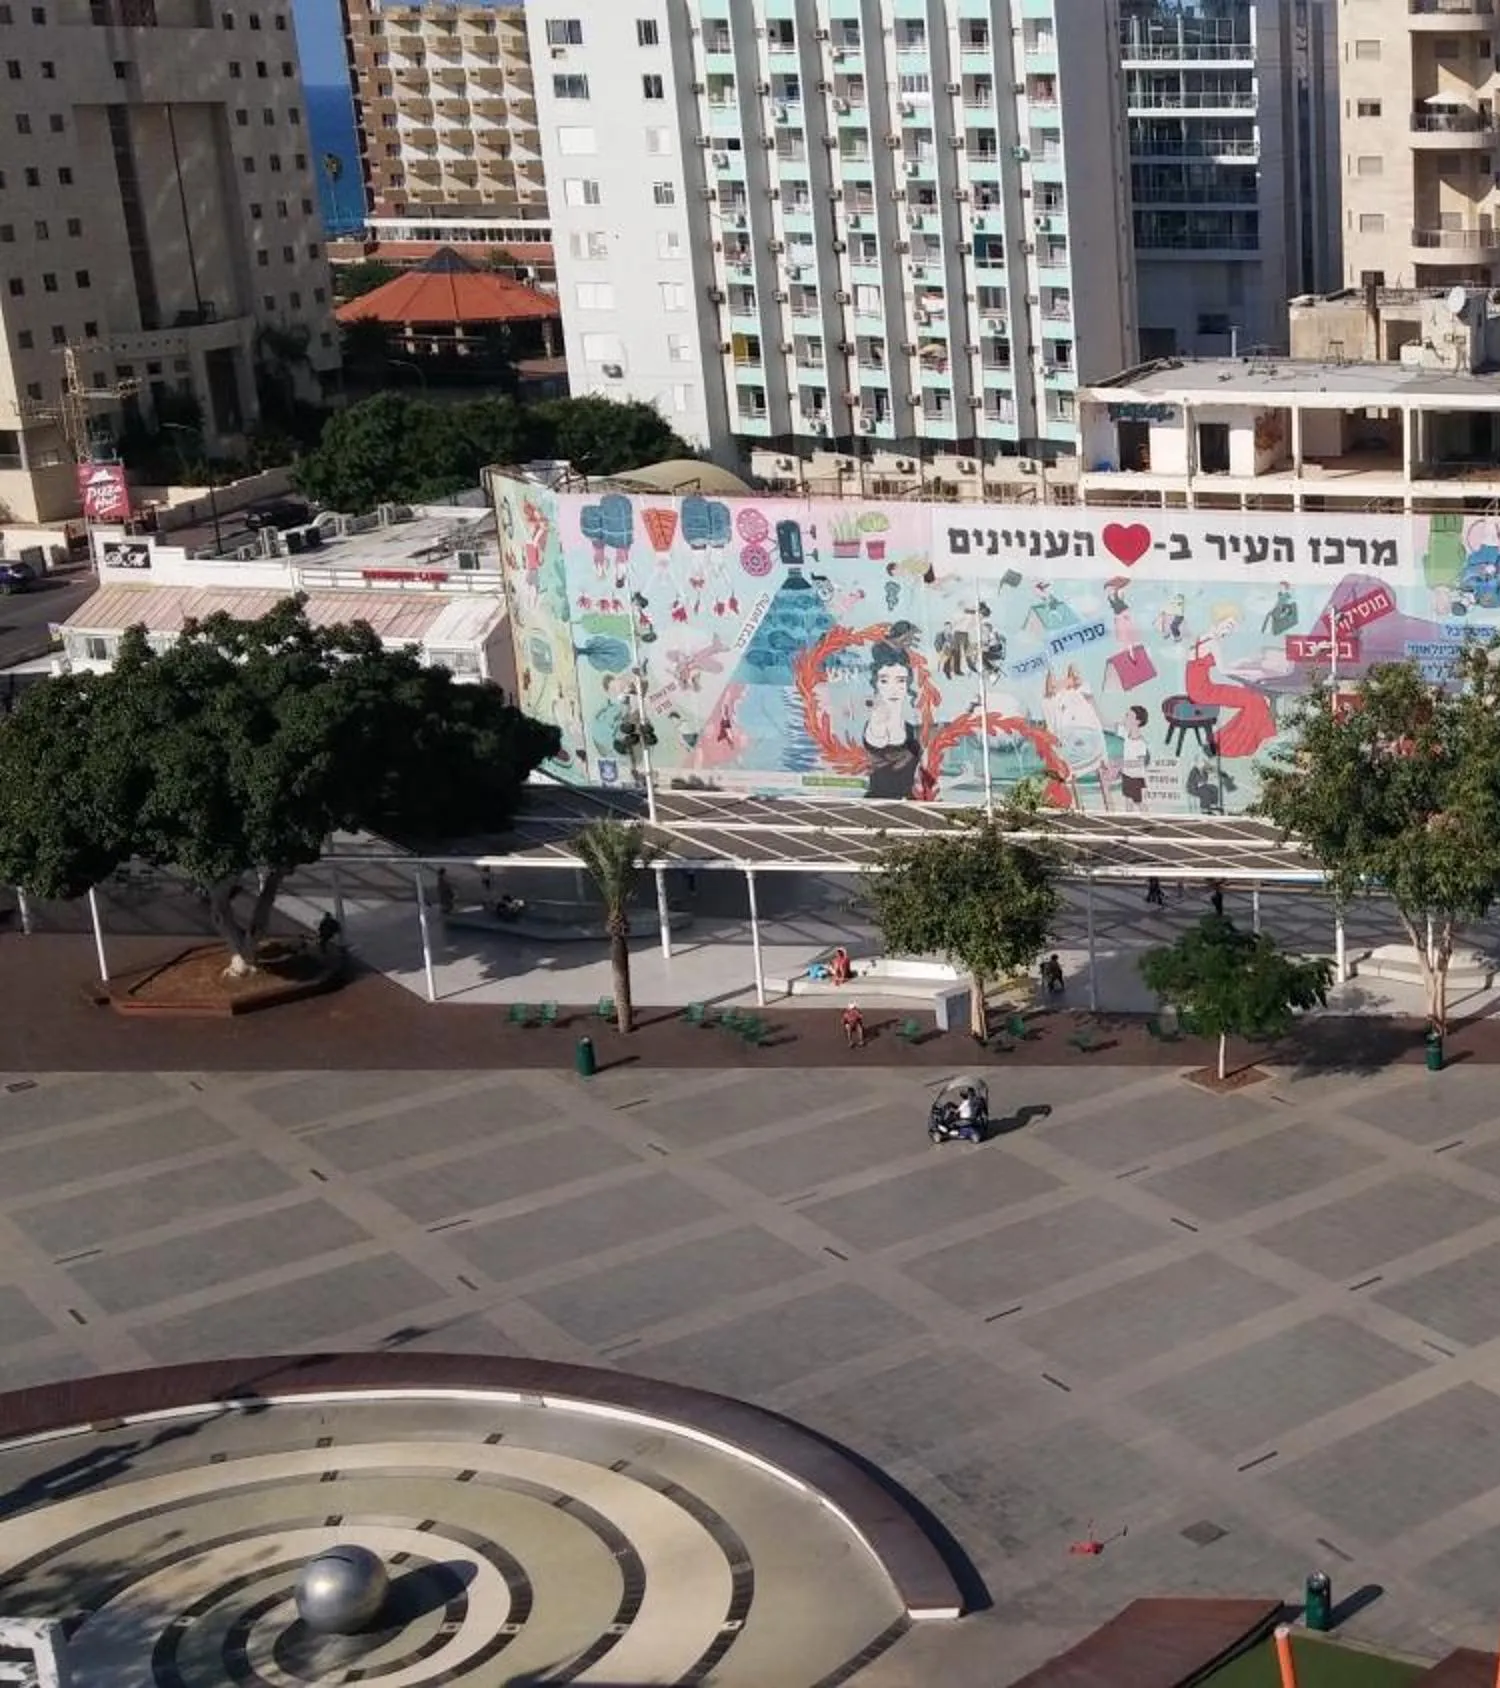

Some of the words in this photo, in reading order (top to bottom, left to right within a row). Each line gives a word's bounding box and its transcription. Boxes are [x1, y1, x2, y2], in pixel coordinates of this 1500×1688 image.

[948, 527, 1095, 559] העניינים
[1205, 535, 1295, 563] העיר
[1308, 536, 1398, 567] מרכז
[1049, 623, 1105, 655] ספריית
